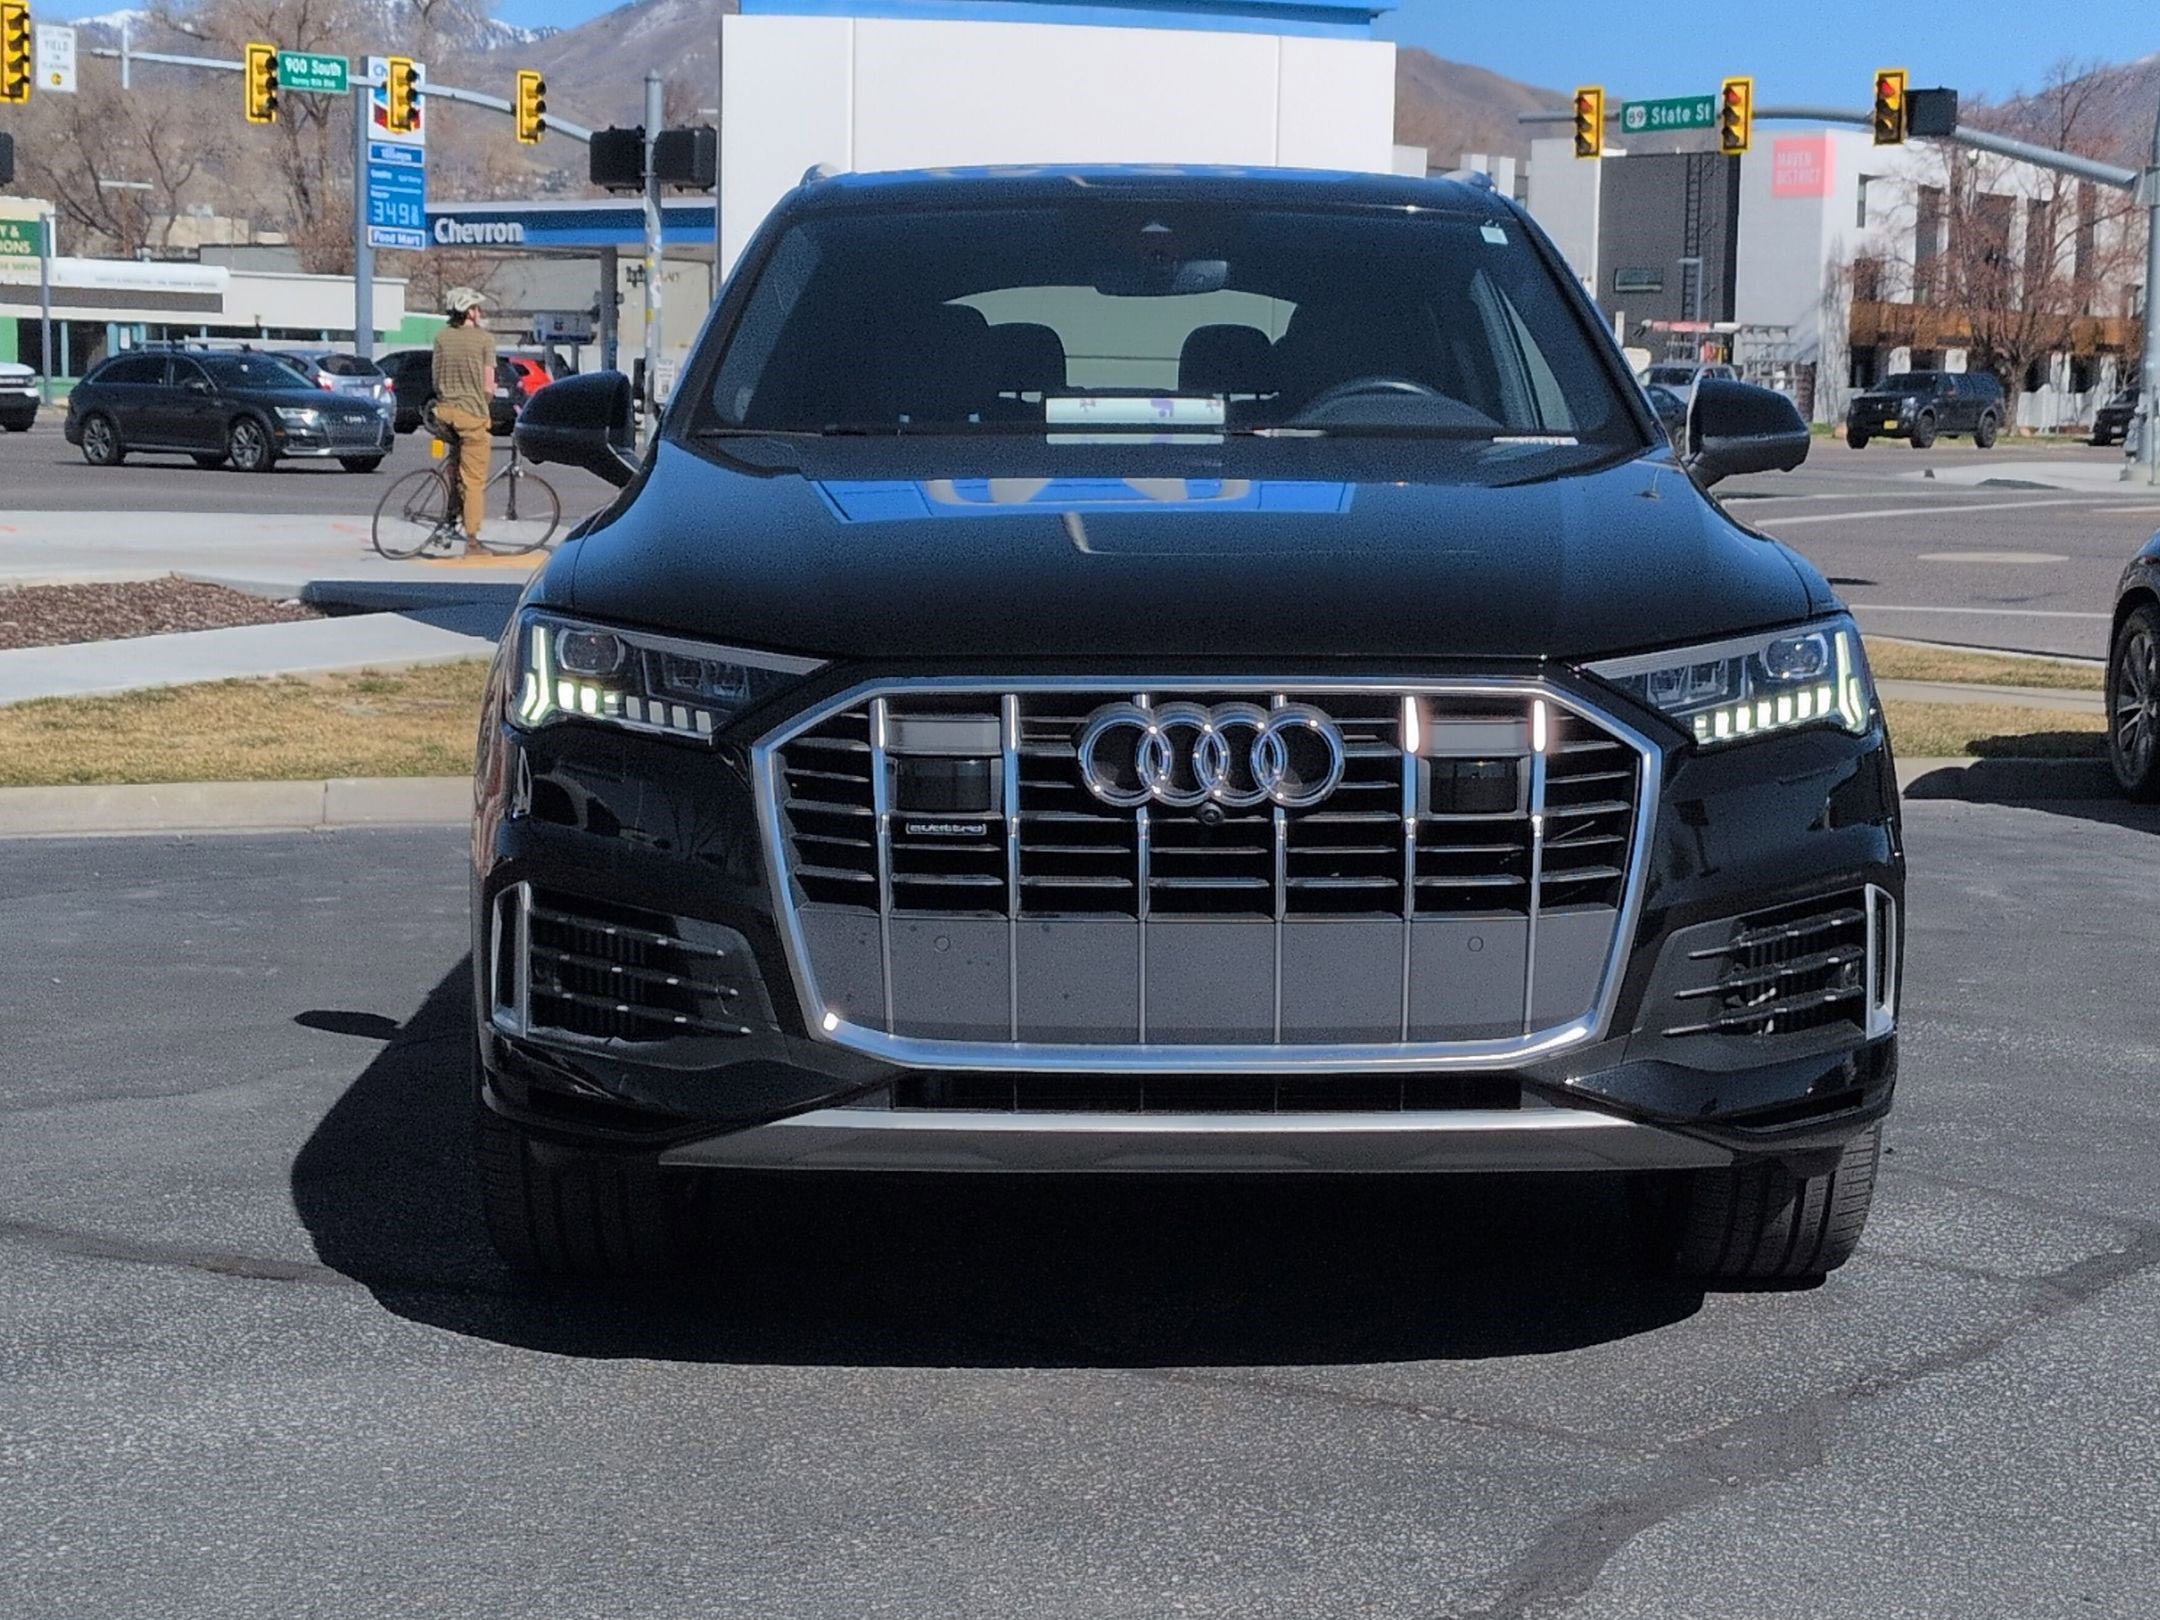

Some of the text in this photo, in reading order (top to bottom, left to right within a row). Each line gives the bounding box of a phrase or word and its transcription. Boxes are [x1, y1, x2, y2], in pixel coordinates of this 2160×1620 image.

[285, 57, 342, 77] 900 South
[1628, 103, 1711, 125] 89 State St
[434, 217, 523, 243] Chevron
